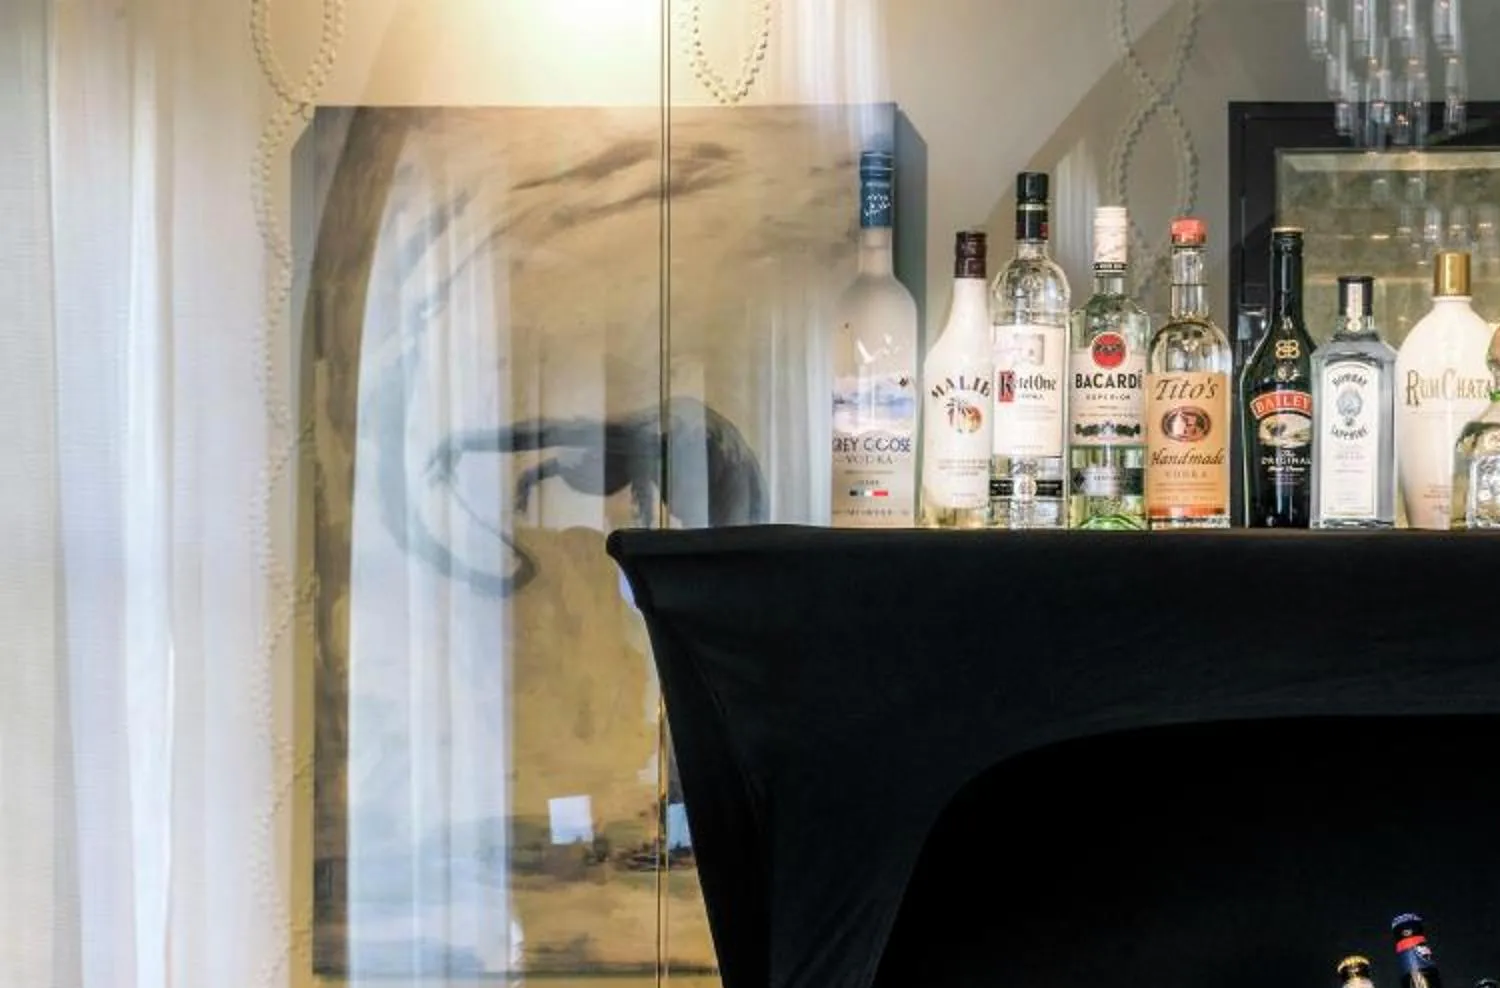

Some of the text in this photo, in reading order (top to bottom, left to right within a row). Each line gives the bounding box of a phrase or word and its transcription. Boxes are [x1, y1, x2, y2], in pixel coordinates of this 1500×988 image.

[931, 375, 990, 398] MALIB
[1156, 377, 1219, 401] Tito's
[1152, 448, 1226, 466] Handmade
